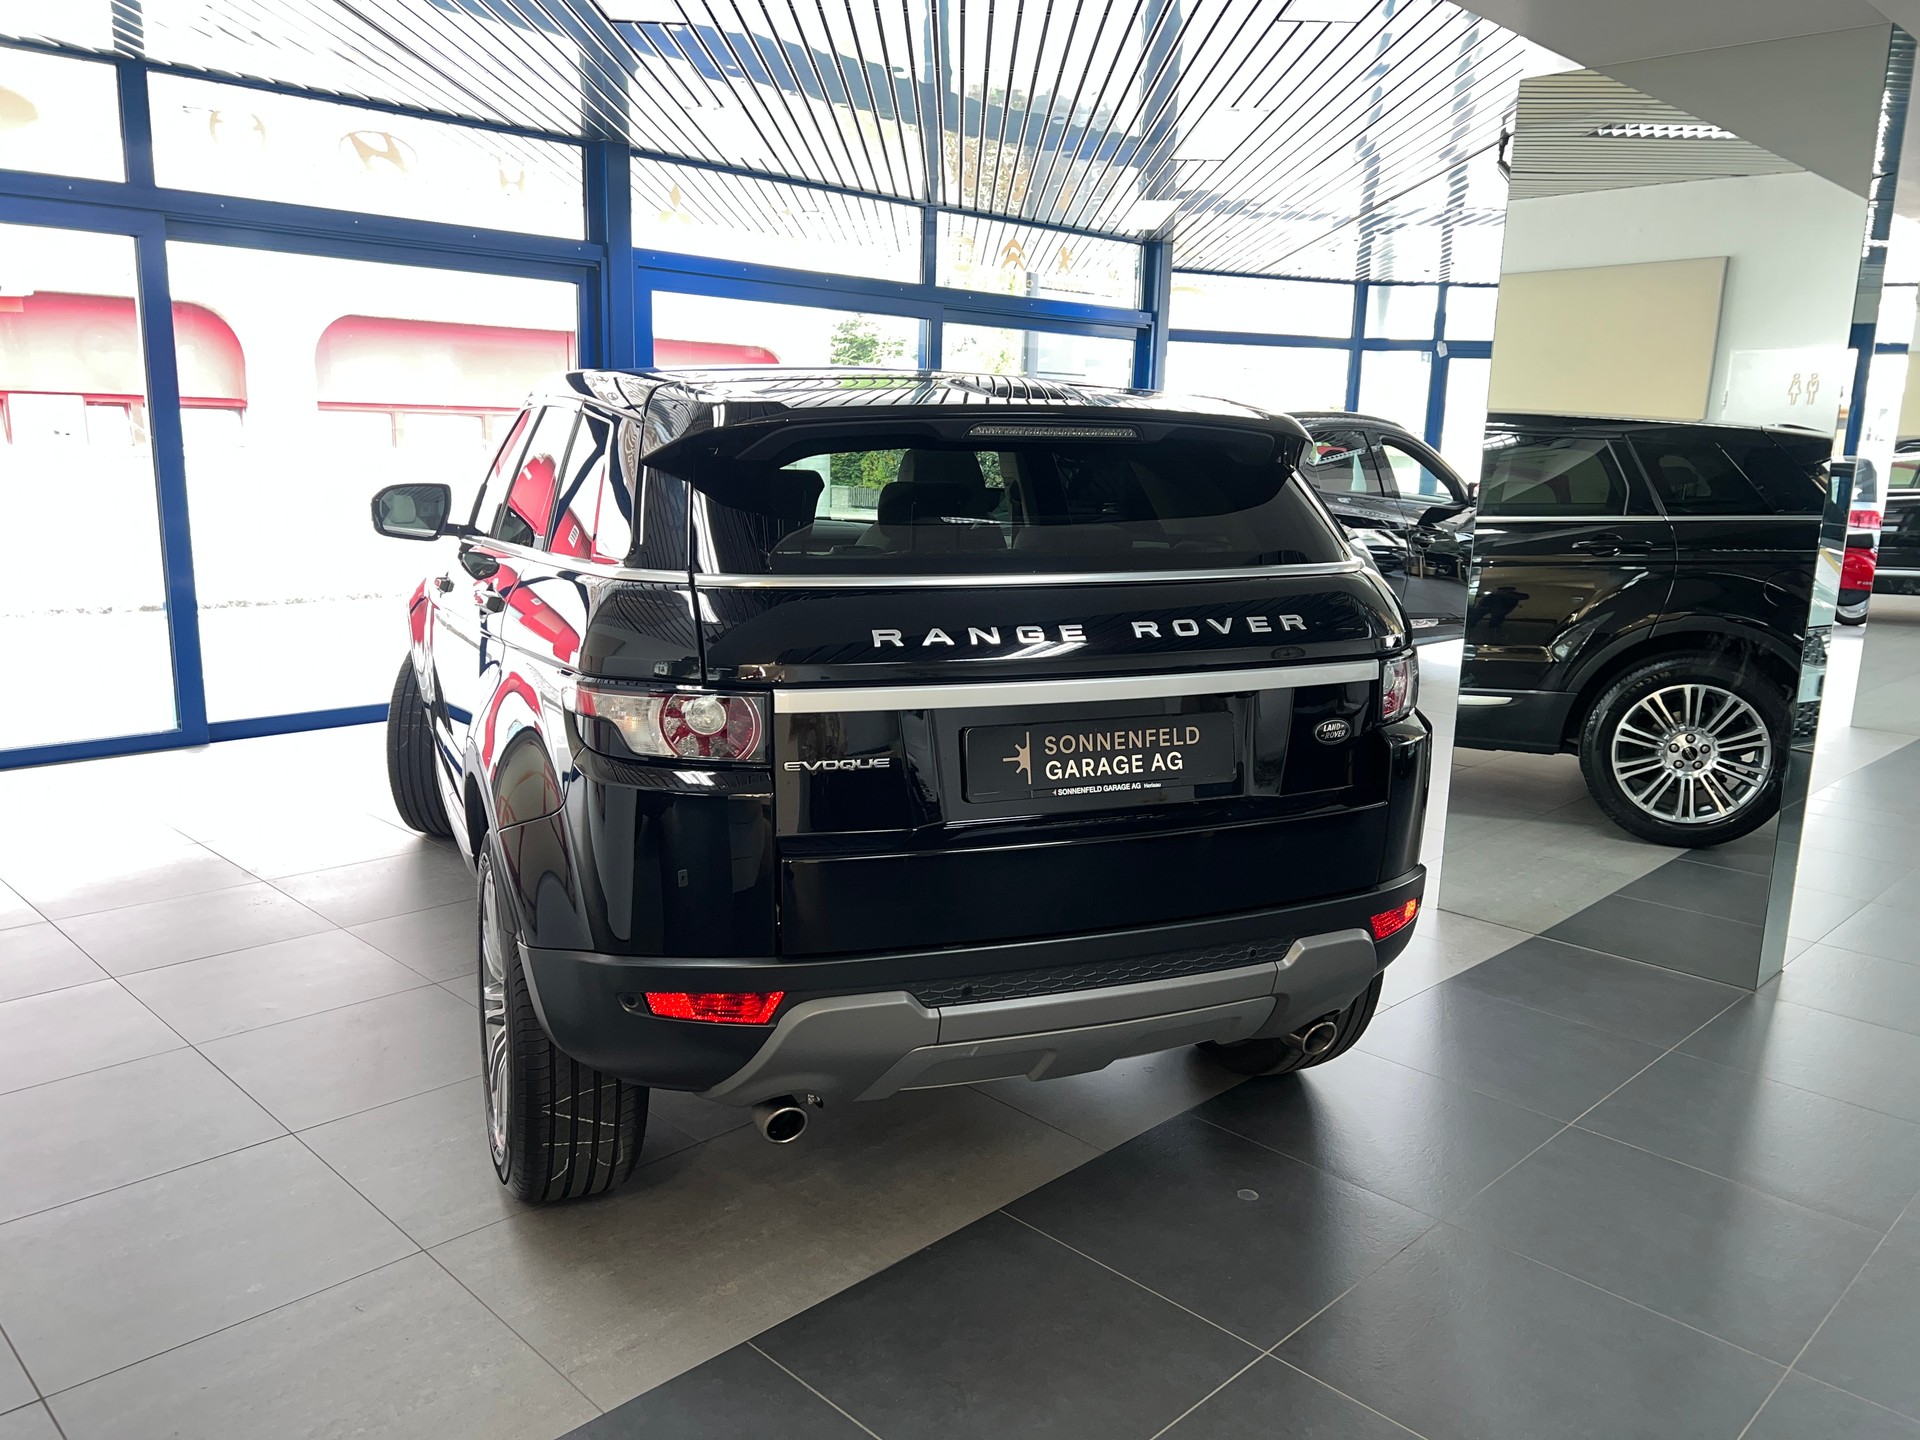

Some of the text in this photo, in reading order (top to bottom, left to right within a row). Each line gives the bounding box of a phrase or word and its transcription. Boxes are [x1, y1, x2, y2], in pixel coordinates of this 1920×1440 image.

[871, 614, 1307, 647] RANGE ROVER
[1044, 726, 1200, 755] SONNENFELD
[783, 758, 890, 771] EVOQUE
[1045, 751, 1184, 780] GARAGE AG
[1058, 785, 1102, 796] SONNENFELD
[1103, 782, 1131, 792] GARAGE
[1131, 782, 1141, 790] AG
